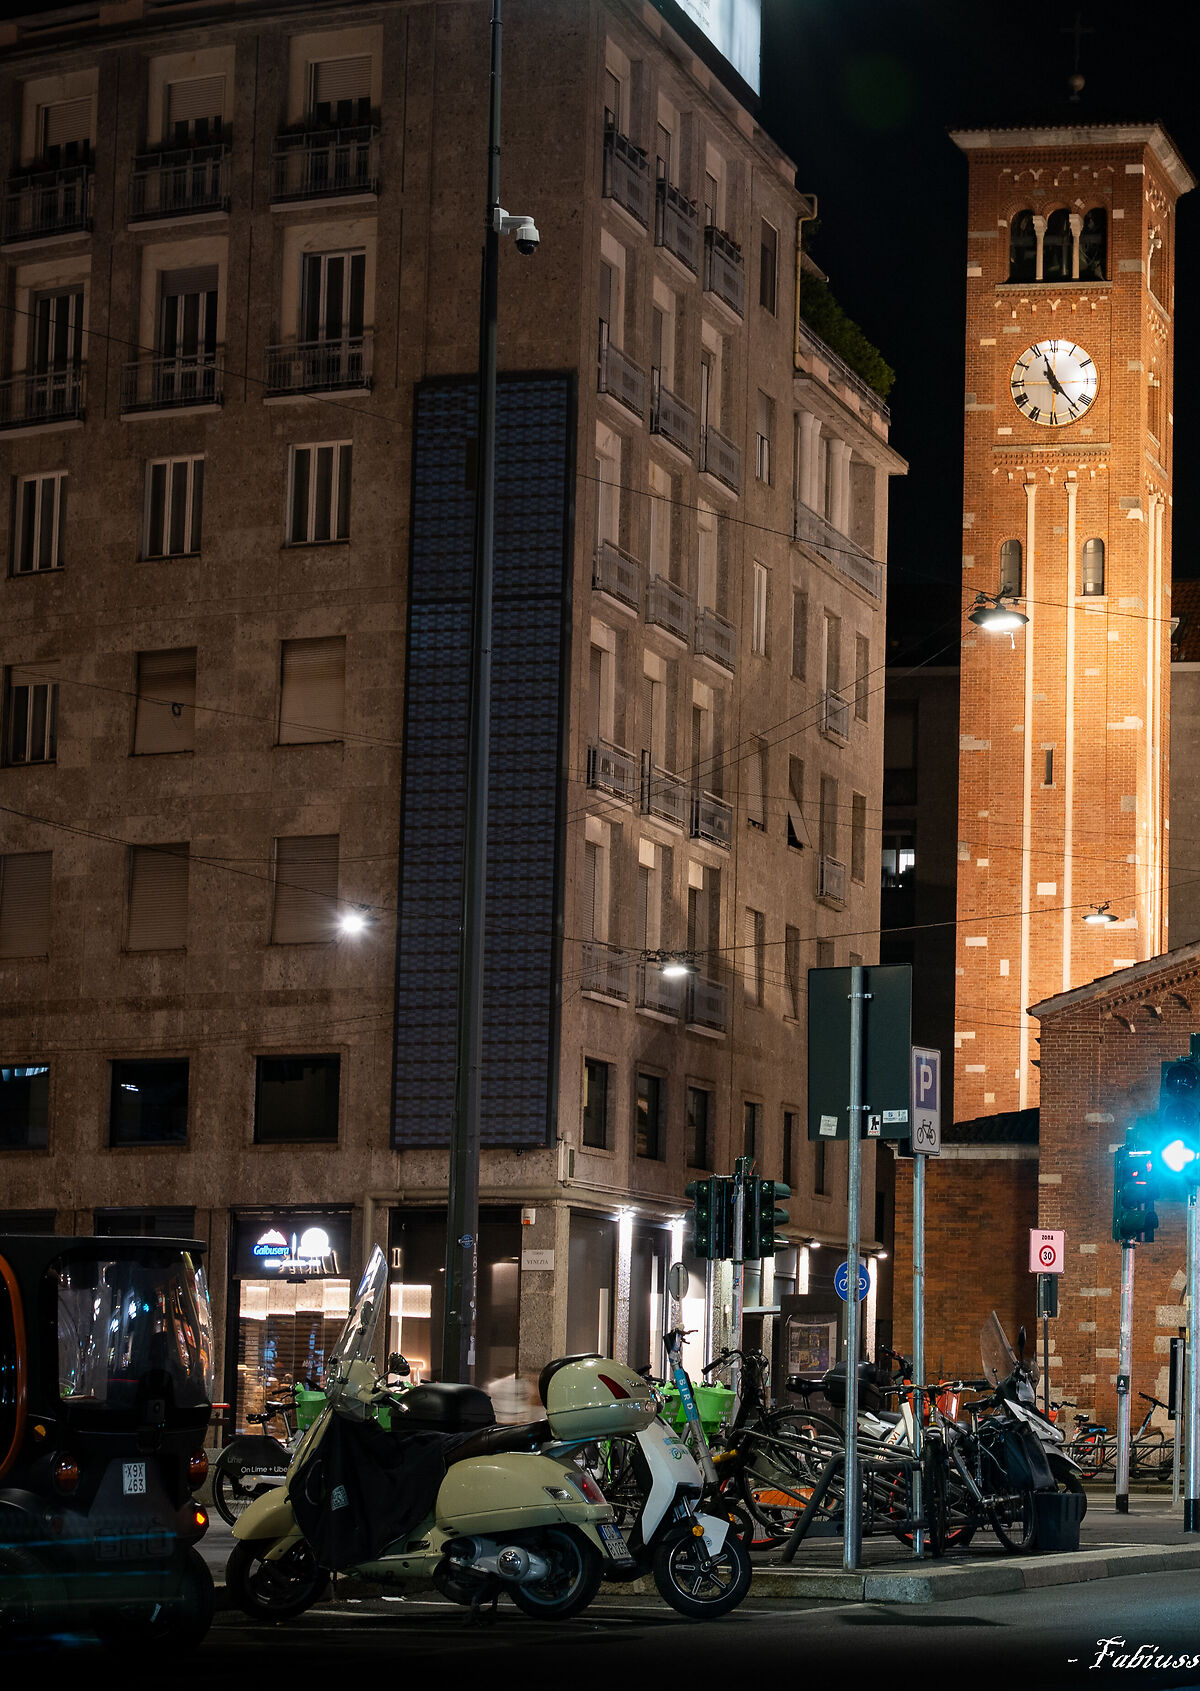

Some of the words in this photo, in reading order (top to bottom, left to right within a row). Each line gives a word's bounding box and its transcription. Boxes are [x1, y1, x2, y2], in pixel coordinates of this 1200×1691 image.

[920, 1064, 933, 1102] P
[253, 1245, 290, 1256] Galbusera
[1043, 1251, 1053, 1261] 30
[679, 1378, 693, 1410] BIRD
[240, 1466, 251, 1474] On
[273, 1465, 289, 1473] Ube
